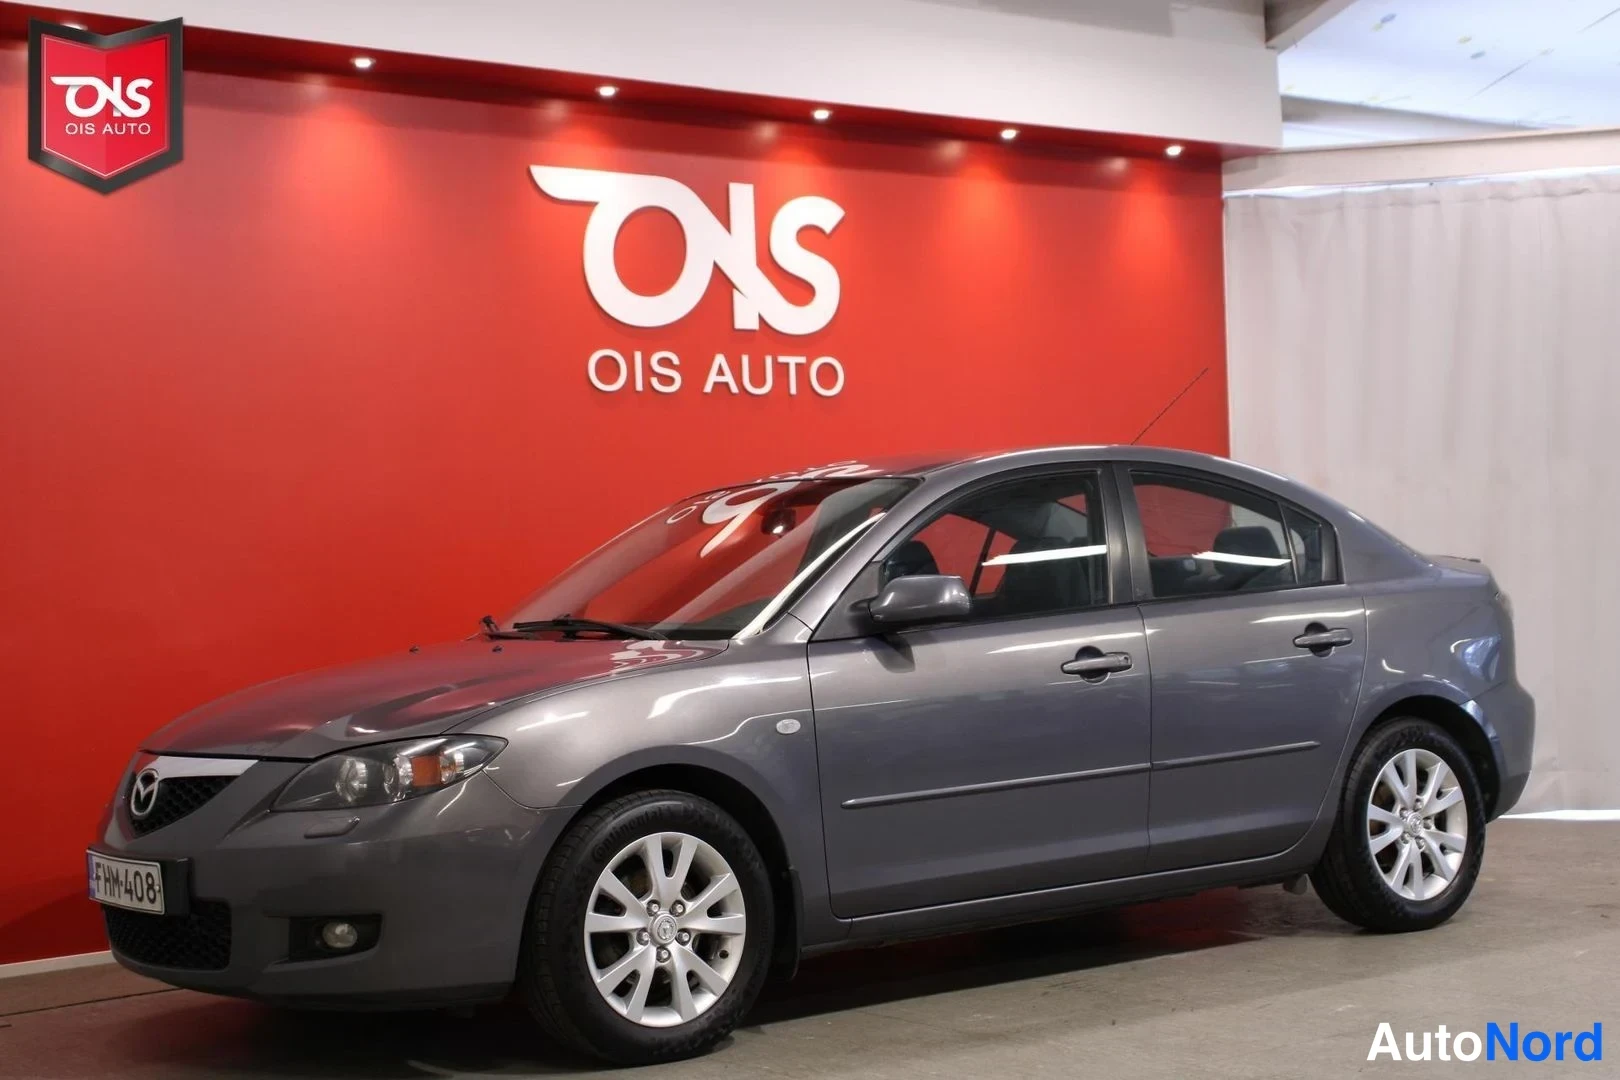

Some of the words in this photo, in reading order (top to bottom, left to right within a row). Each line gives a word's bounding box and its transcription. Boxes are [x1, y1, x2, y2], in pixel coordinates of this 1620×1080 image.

[529, 165, 846, 335] OIS
[587, 349, 682, 393] OIS
[703, 353, 845, 397] AUTO
[94, 861, 157, 904] FHM-408
